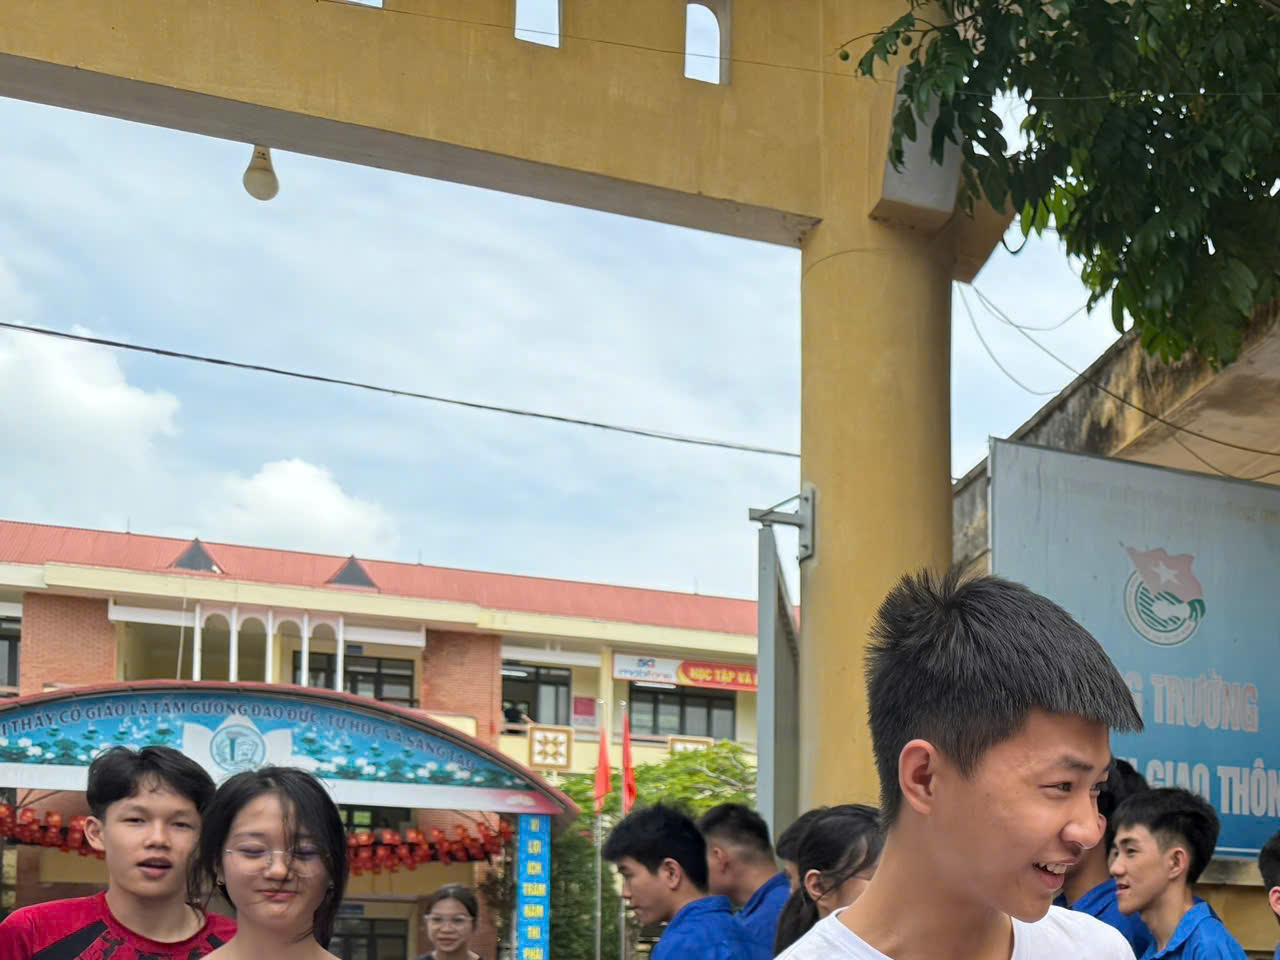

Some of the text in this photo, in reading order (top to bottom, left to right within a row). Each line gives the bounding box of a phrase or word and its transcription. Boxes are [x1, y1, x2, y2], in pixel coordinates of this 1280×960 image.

[59, 706, 81, 724] CÔ
[87, 701, 127, 720] GIÁO
[131, 699, 148, 716] LÀ
[153, 697, 185, 714] TẤM
[1151, 668, 1258, 733] TRƯỜNG
[1145, 760, 1210, 803] GIAO
